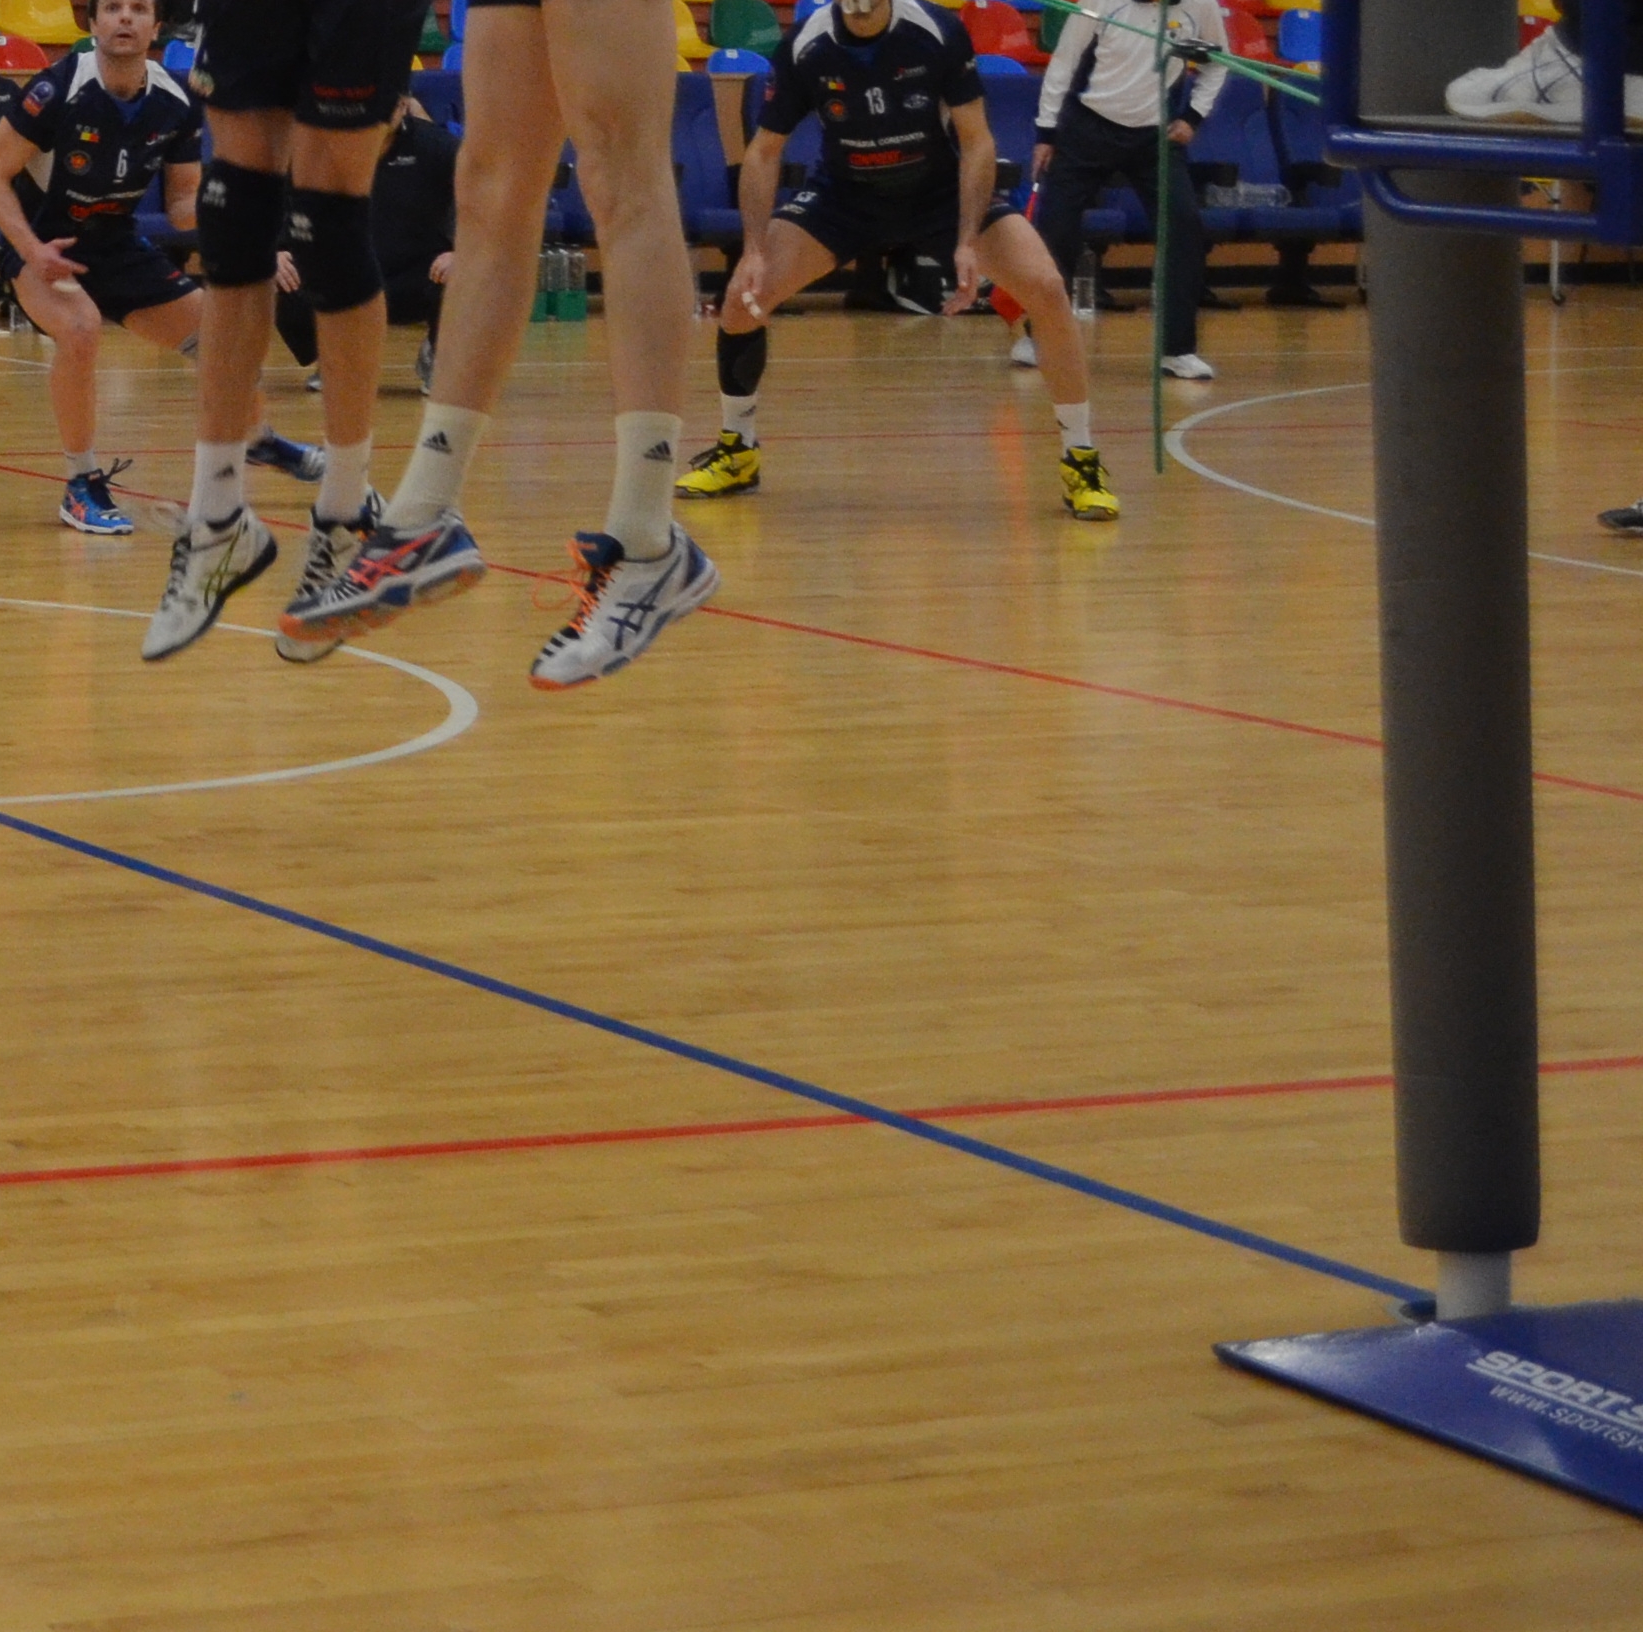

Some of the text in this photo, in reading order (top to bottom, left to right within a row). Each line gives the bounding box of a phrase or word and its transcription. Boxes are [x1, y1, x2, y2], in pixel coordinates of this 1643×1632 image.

[865, 86, 885, 115] 13
[116, 148, 128, 177] 6
[1489, 1383, 1643, 1453] www.sportsy
